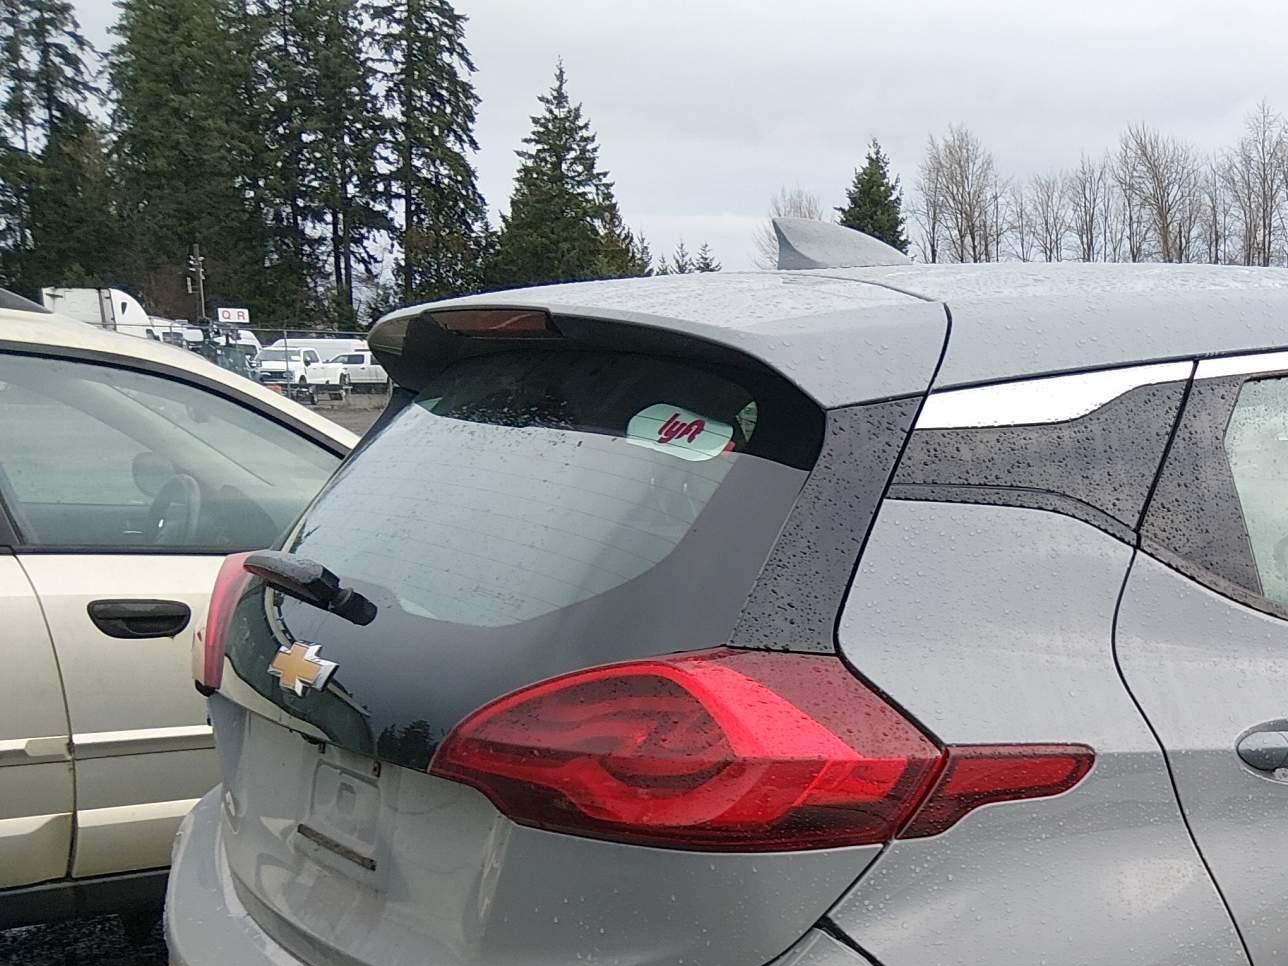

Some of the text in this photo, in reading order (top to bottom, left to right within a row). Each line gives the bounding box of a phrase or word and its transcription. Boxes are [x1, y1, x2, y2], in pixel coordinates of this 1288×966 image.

[221, 310, 246, 321] Q R
[657, 412, 706, 444] lyft
